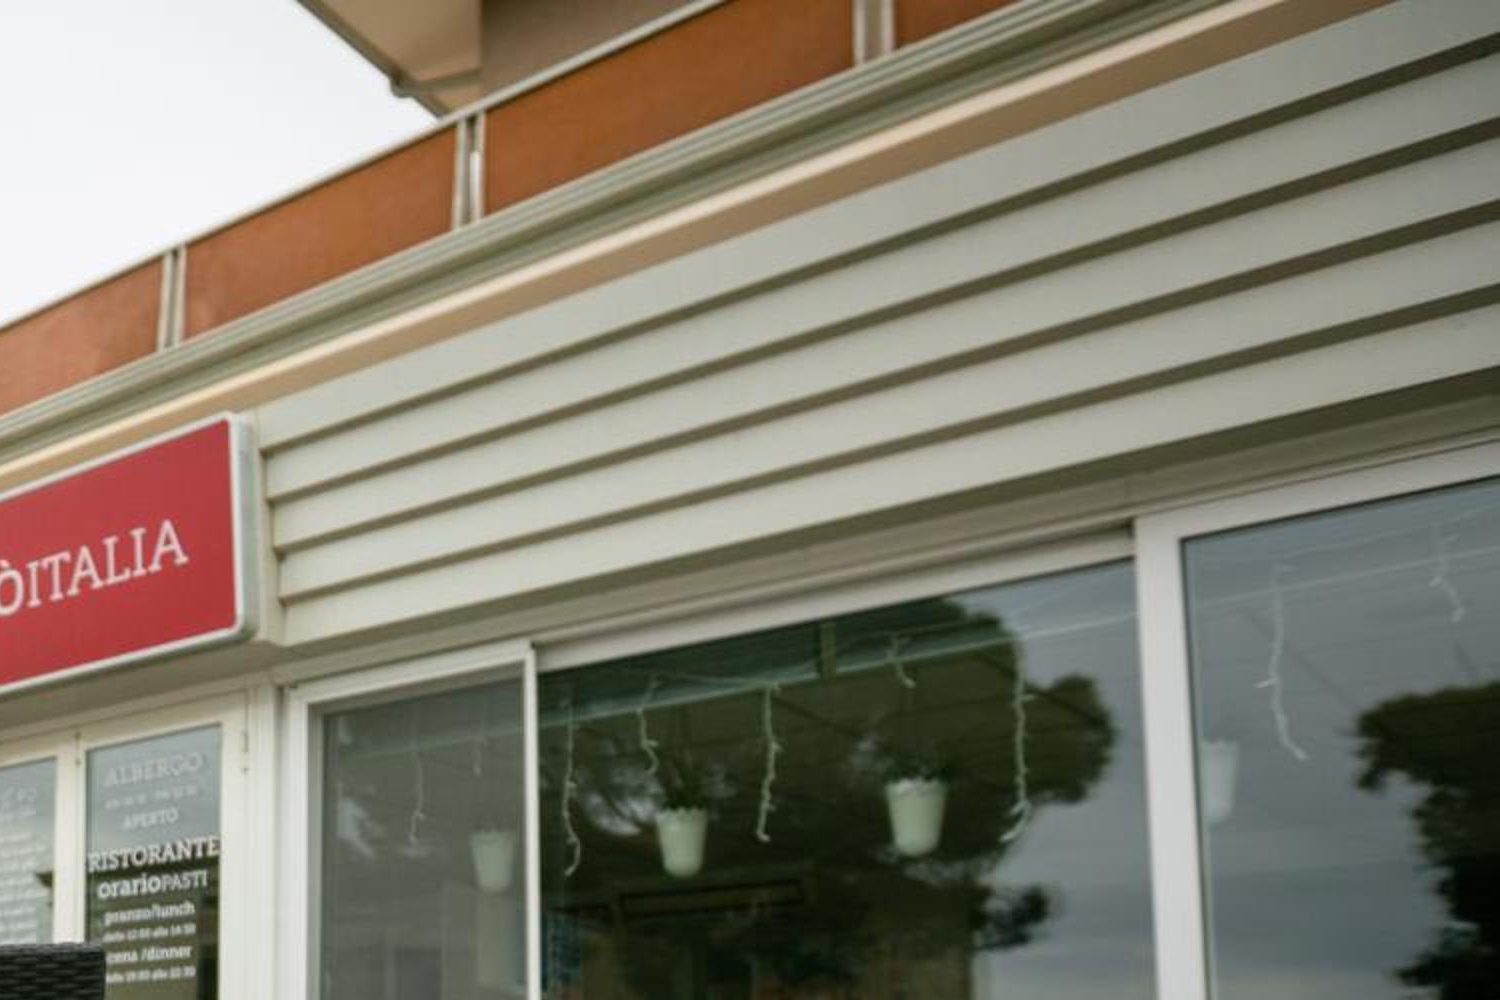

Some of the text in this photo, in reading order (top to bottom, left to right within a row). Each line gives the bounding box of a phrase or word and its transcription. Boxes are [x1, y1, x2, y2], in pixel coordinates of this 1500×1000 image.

[105, 753, 203, 787] ALBERGO
[88, 836, 220, 872] RISTORANTE
[98, 869, 208, 899] orarioPASTI
